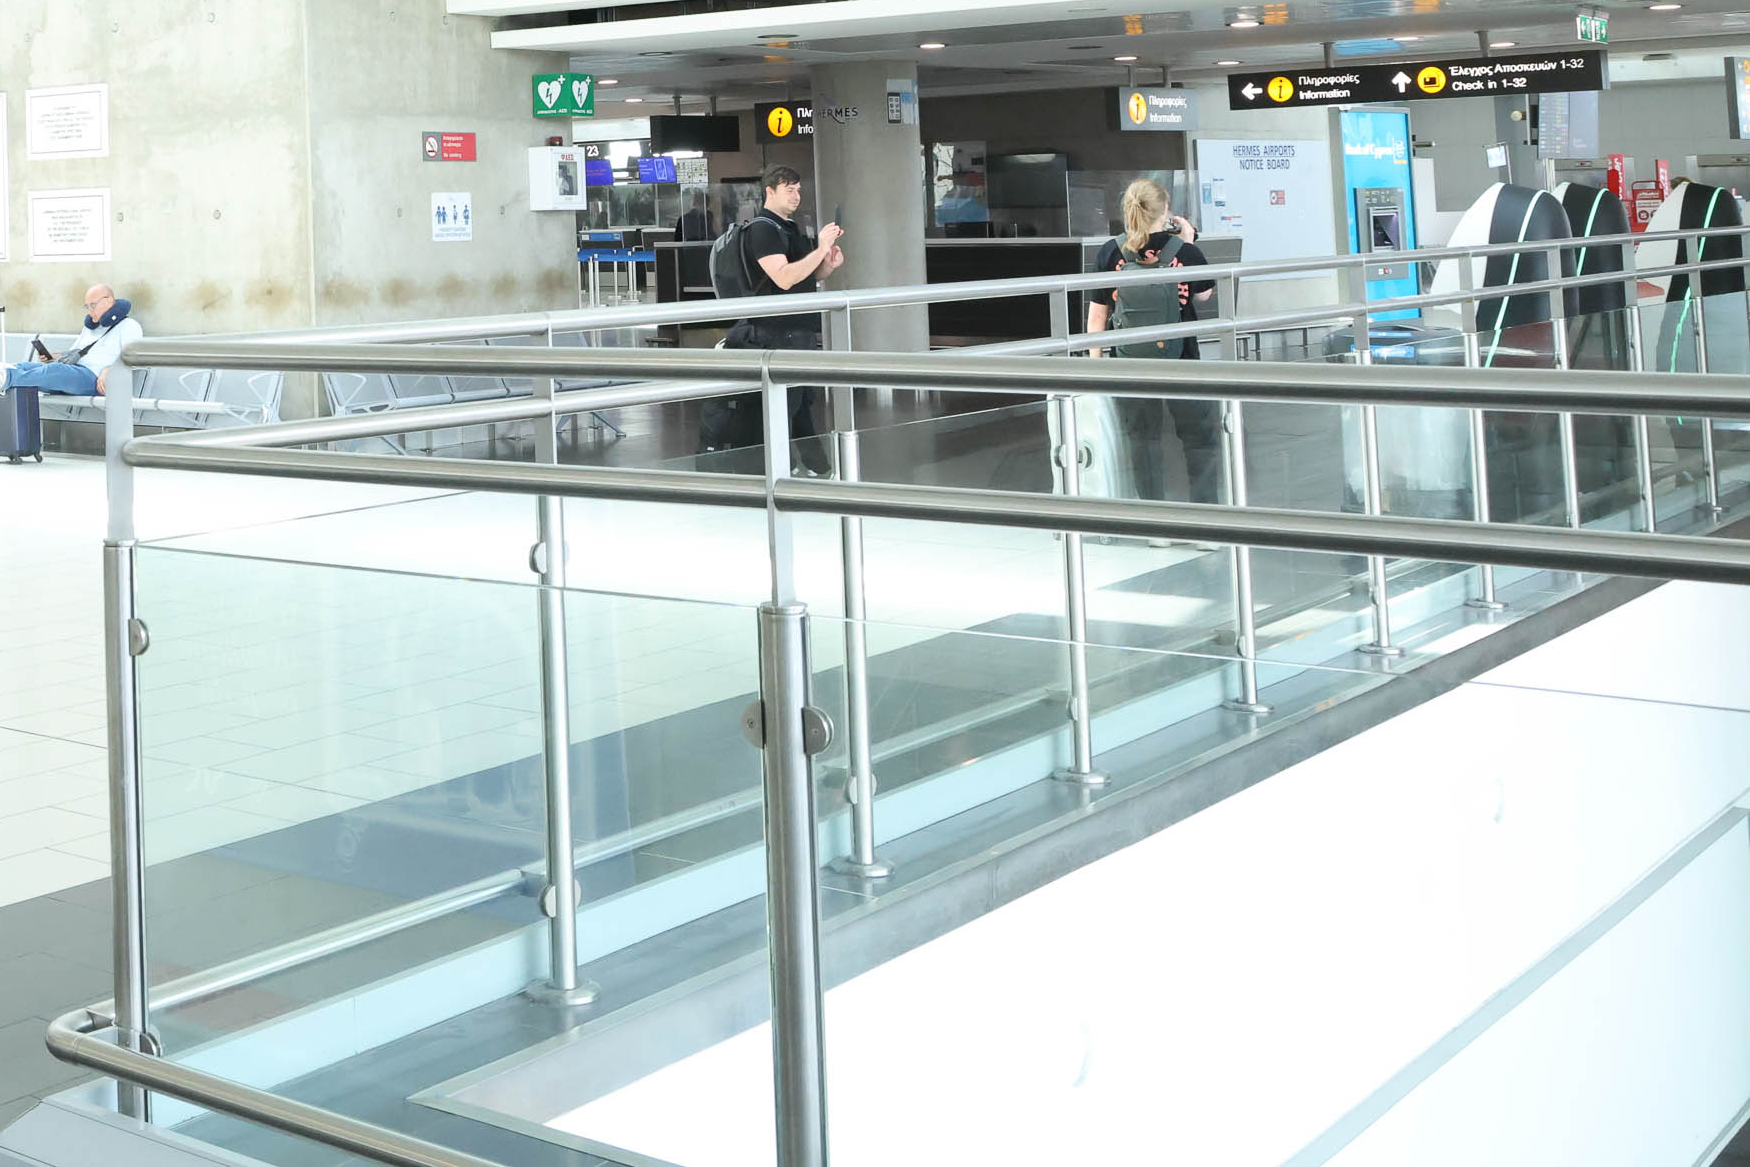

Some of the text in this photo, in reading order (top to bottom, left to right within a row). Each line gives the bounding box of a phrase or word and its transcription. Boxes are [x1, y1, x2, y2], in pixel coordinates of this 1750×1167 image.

[1560, 58, 1585, 69] 1-32
[1298, 74, 1360, 87] Πληροφορίες
[1452, 77, 1527, 91] Check in 1-32
[1299, 89, 1351, 100] Information
[586, 145, 600, 157] 23
[1233, 145, 1296, 156] HERMES AIRPORTS
[1239, 158, 1290, 170] NOTICE BOARD
